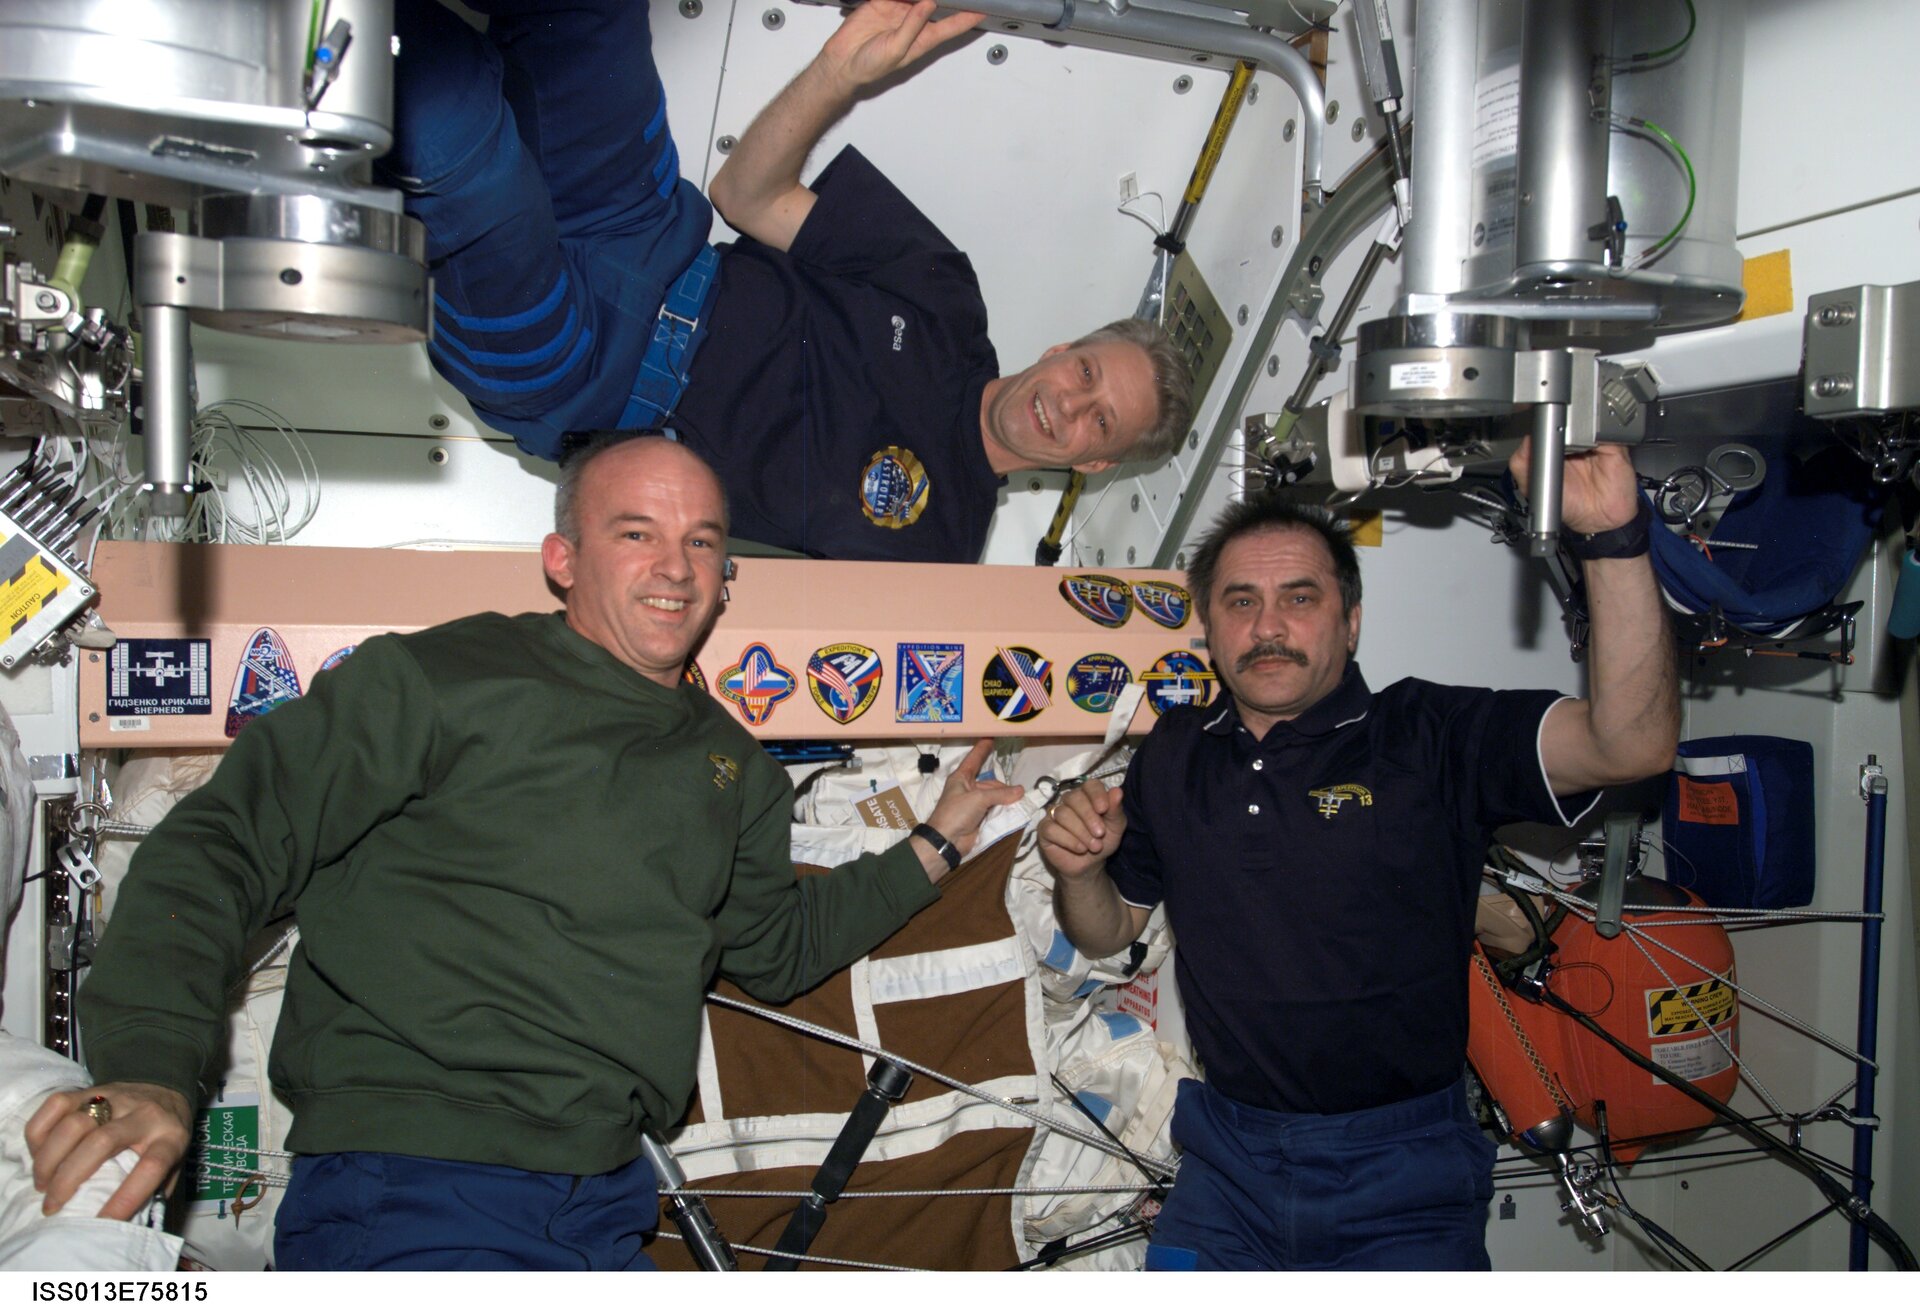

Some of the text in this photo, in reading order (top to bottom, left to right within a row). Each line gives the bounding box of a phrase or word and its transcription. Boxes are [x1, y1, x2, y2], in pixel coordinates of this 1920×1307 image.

[893, 329, 902, 351] esa
[875, 458, 892, 513] ASTROLAB
[10, 593, 41, 620] CAUTION
[262, 645, 272, 660] 2
[825, 645, 861, 654] EXPEDITION
[1111, 666, 1125, 681] 11
[984, 680, 1002, 688] CHIAO
[108, 697, 210, 708] ГИДЗЕНКО КРИКАЛЁВ
[134, 706, 184, 714] SHEPHERD
[1360, 794, 1373, 806] 13
[1681, 995, 1709, 1007] WRNING
[1709, 991, 1724, 1000] CREW
[1123, 997, 1150, 1017] APPARATUS
[196, 1115, 211, 1192] TECHNCAL
